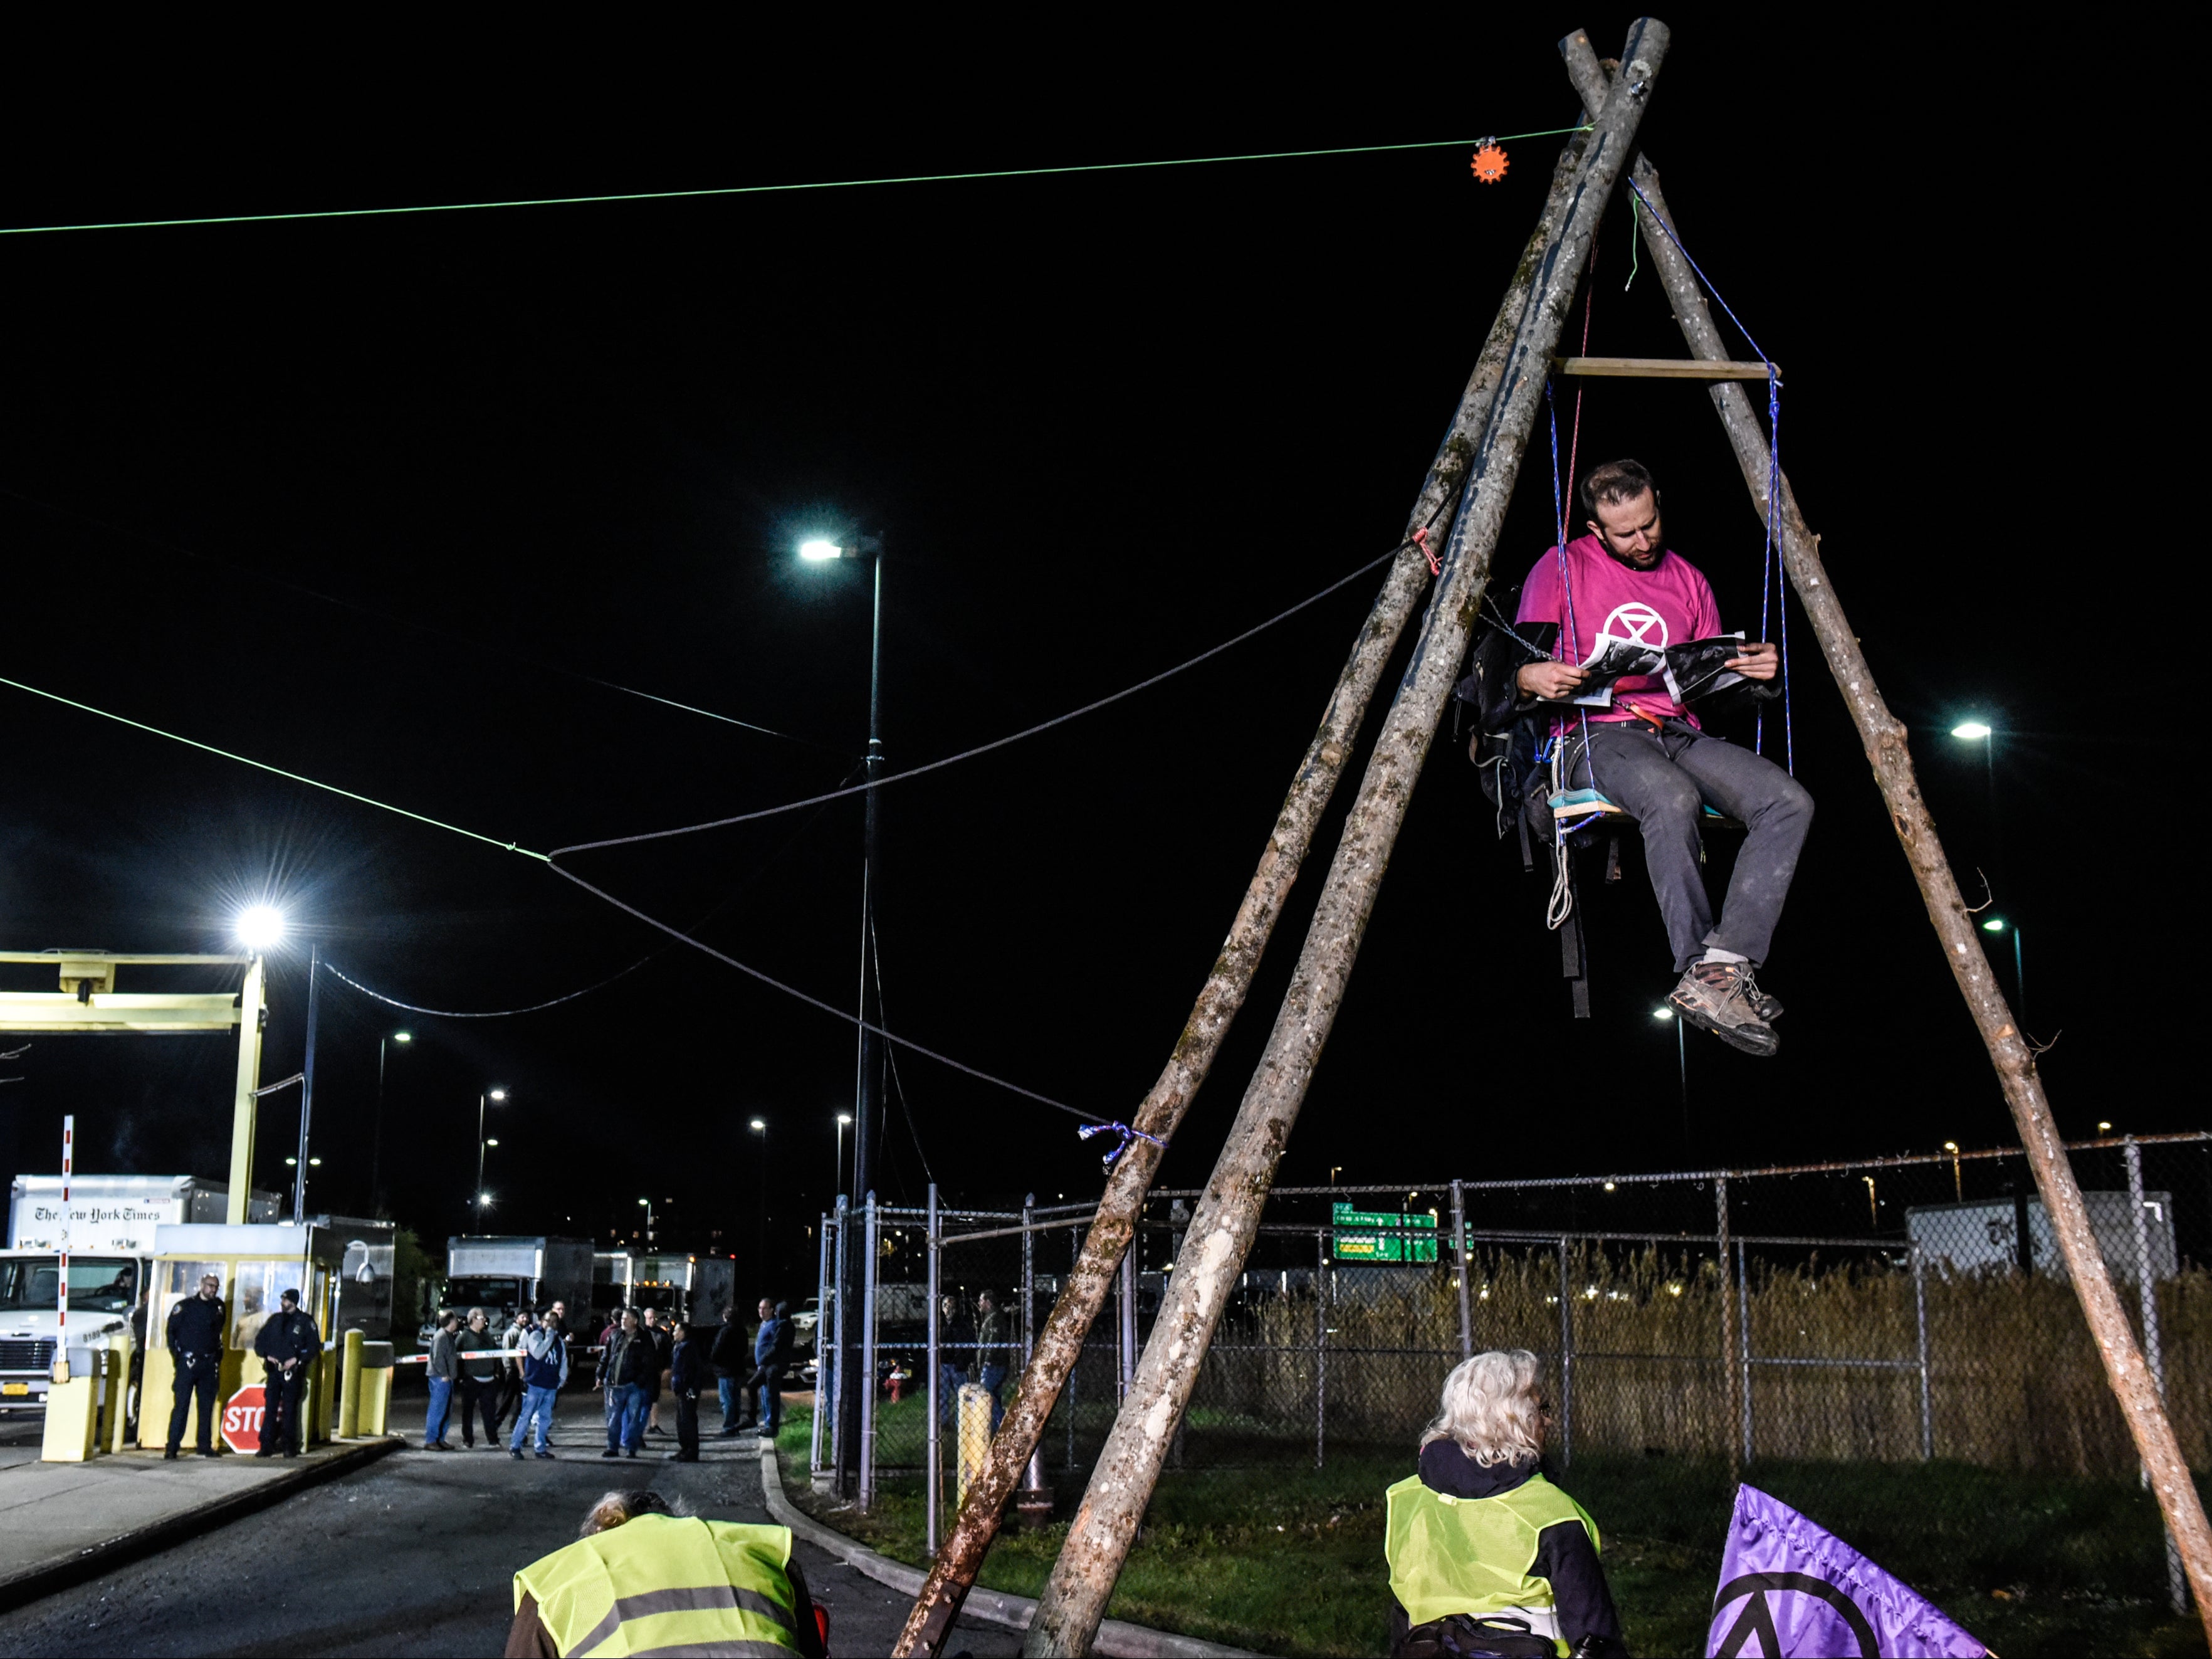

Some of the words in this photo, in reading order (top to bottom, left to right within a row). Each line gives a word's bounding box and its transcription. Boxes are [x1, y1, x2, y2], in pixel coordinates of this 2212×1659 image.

[35, 1207, 58, 1221] The
[60, 1208, 86, 1221] ew
[90, 1208, 120, 1223] York
[123, 1208, 160, 1221] Times
[83, 1330, 100, 1343] 8189
[226, 1406, 266, 1433] STO
